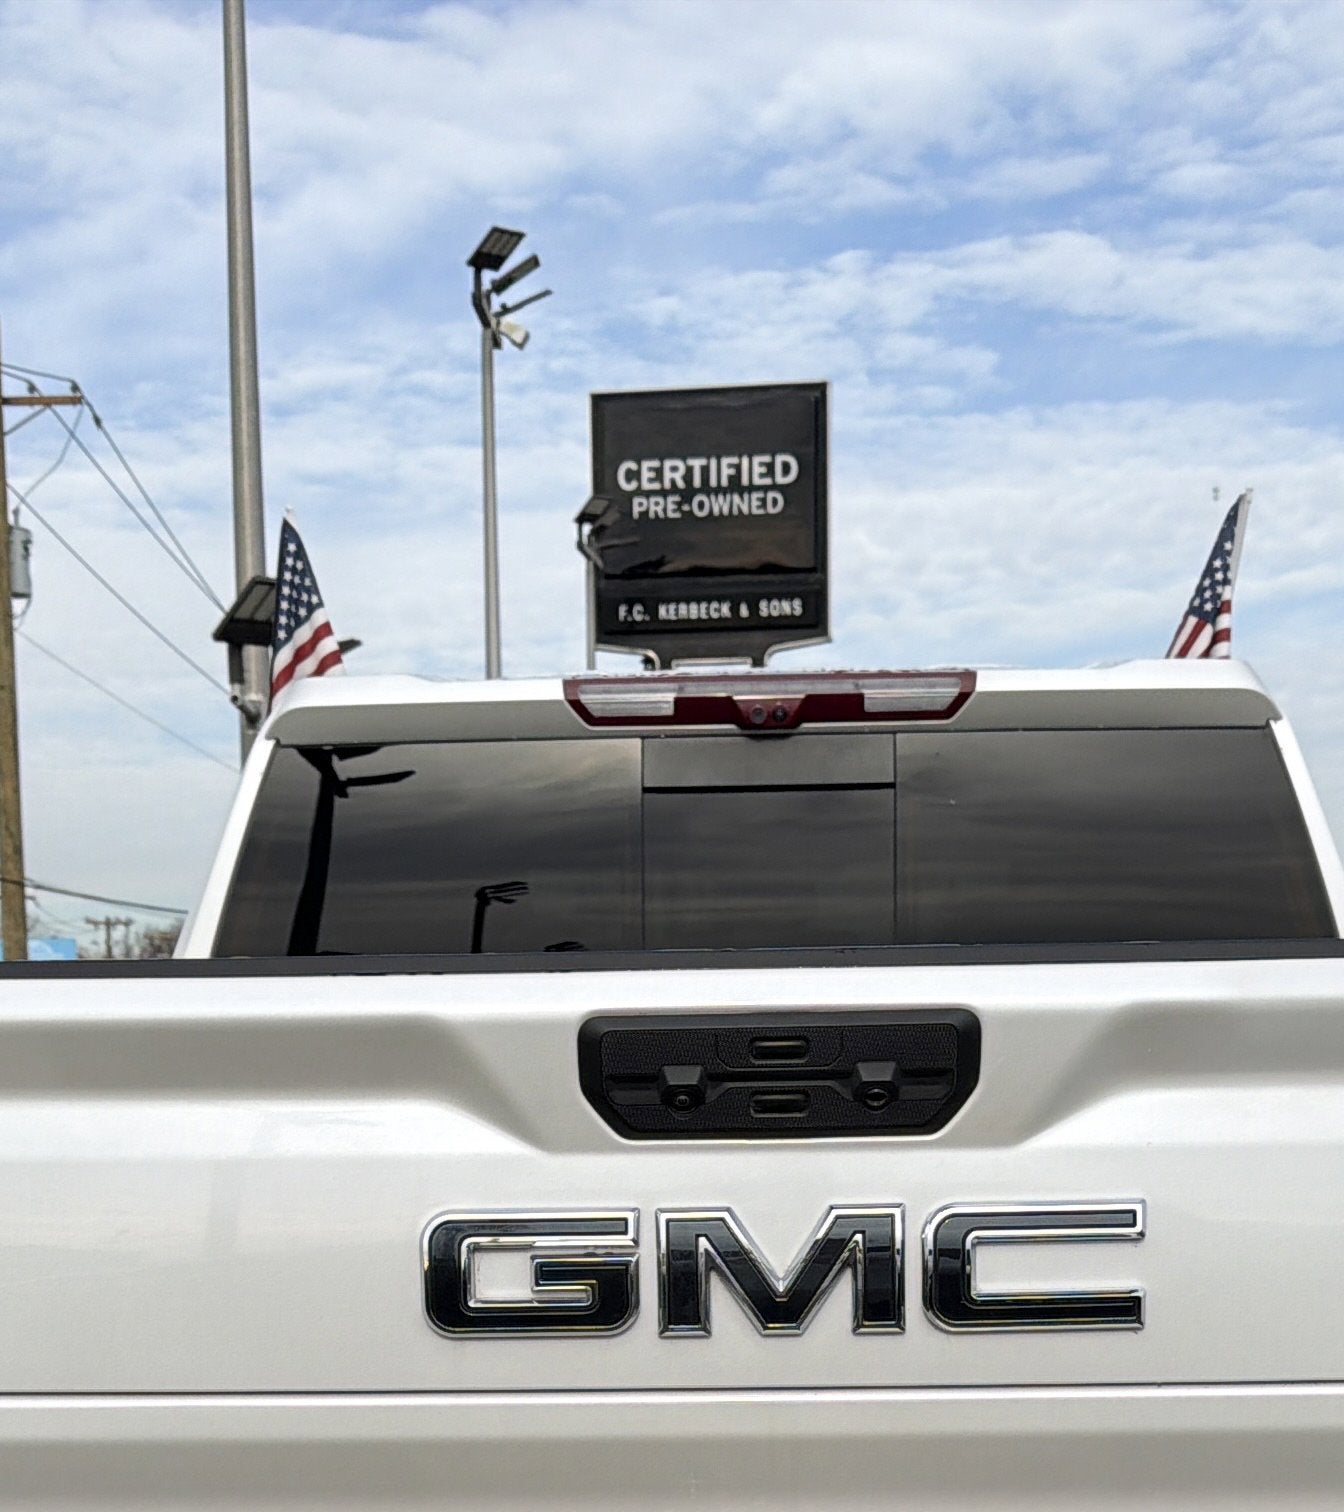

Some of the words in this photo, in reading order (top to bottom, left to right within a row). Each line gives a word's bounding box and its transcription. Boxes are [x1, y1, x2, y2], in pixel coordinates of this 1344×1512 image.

[616, 453, 799, 492] CERTIFIED
[631, 491, 785, 520] PRE-OWNED
[618, 604, 651, 622] F.C.
[658, 601, 732, 620] KERBECK
[758, 598, 803, 617] SONS
[421, 1198, 1147, 1338] GMC
